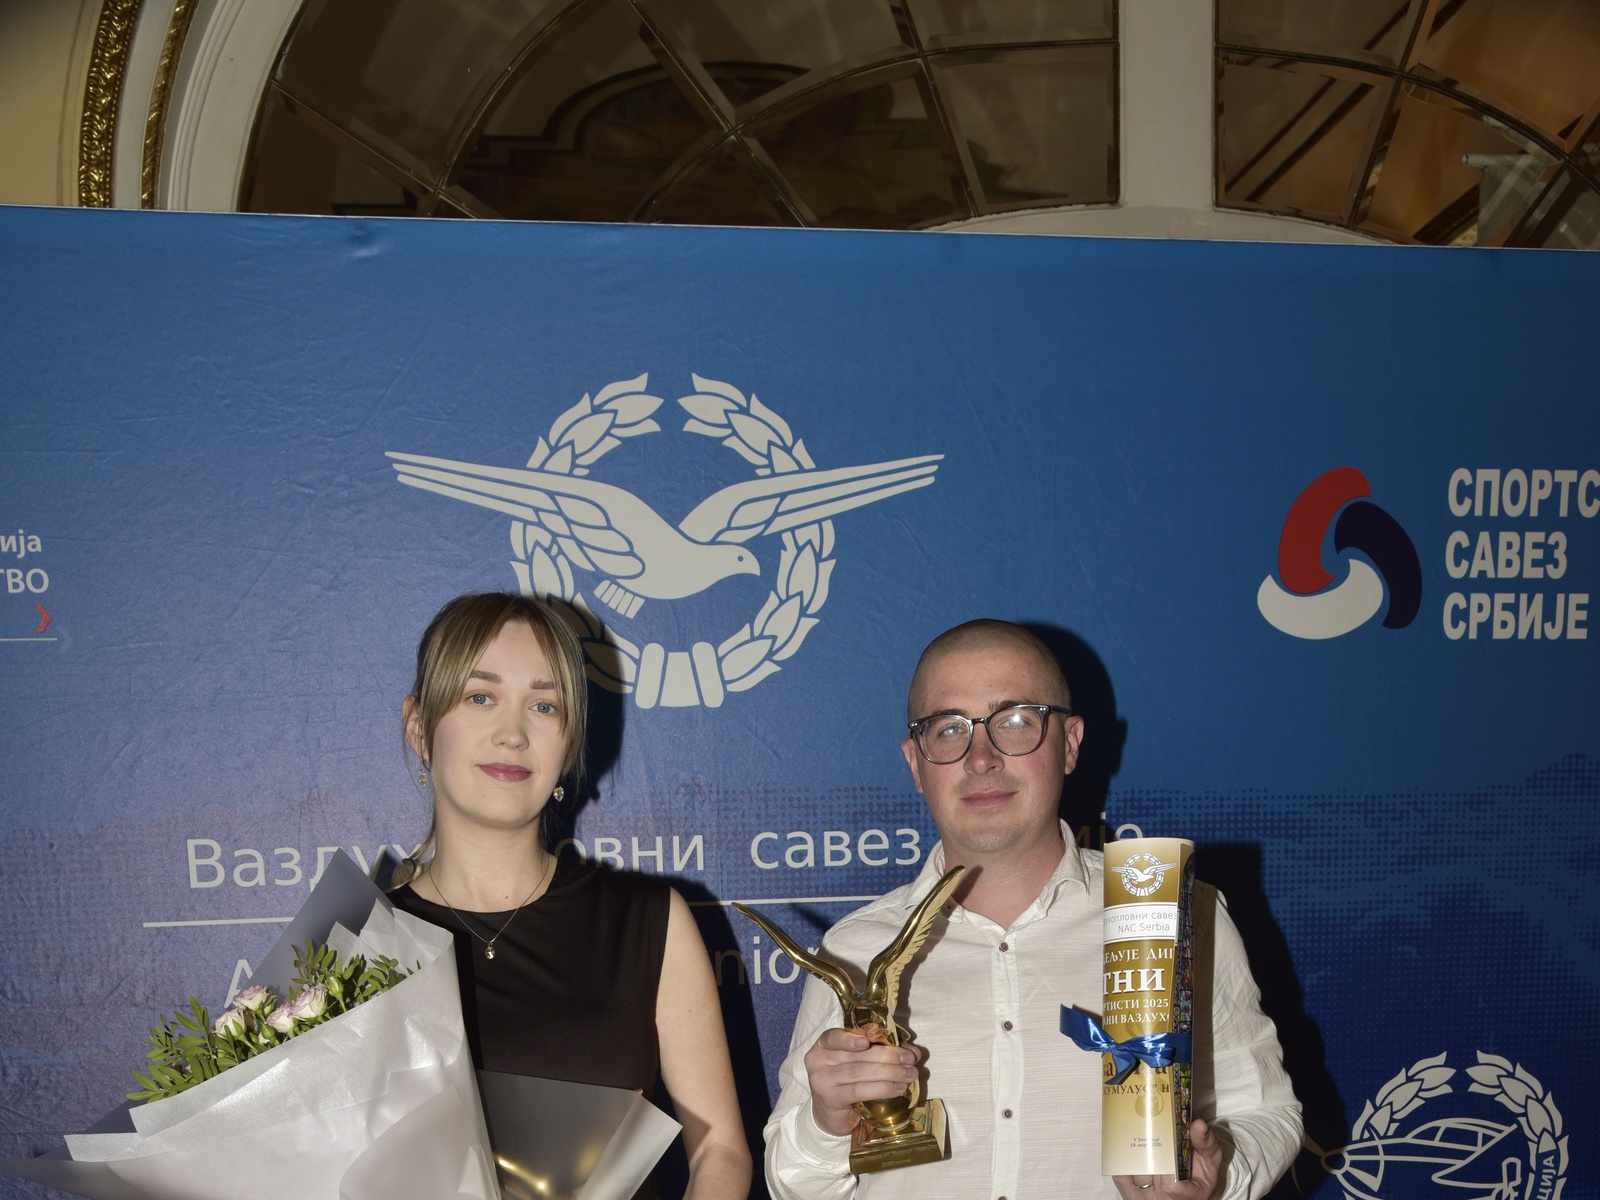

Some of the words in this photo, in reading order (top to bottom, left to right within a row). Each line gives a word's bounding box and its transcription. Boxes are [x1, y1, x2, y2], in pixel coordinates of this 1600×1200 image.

[1448, 468, 1600, 518] СПОРТС
[1445, 530, 1567, 579] САВЕЗ
[1443, 592, 1589, 640] СРБИЈЕ
[750, 828, 921, 870] савез
[1118, 923, 1136, 933] NAC
[1140, 922, 1170, 932] Serbia
[1151, 912, 1177, 920] савез
[1103, 948, 1140, 964] ЕЉУЈЕ
[1143, 998, 1169, 1008] 2025
